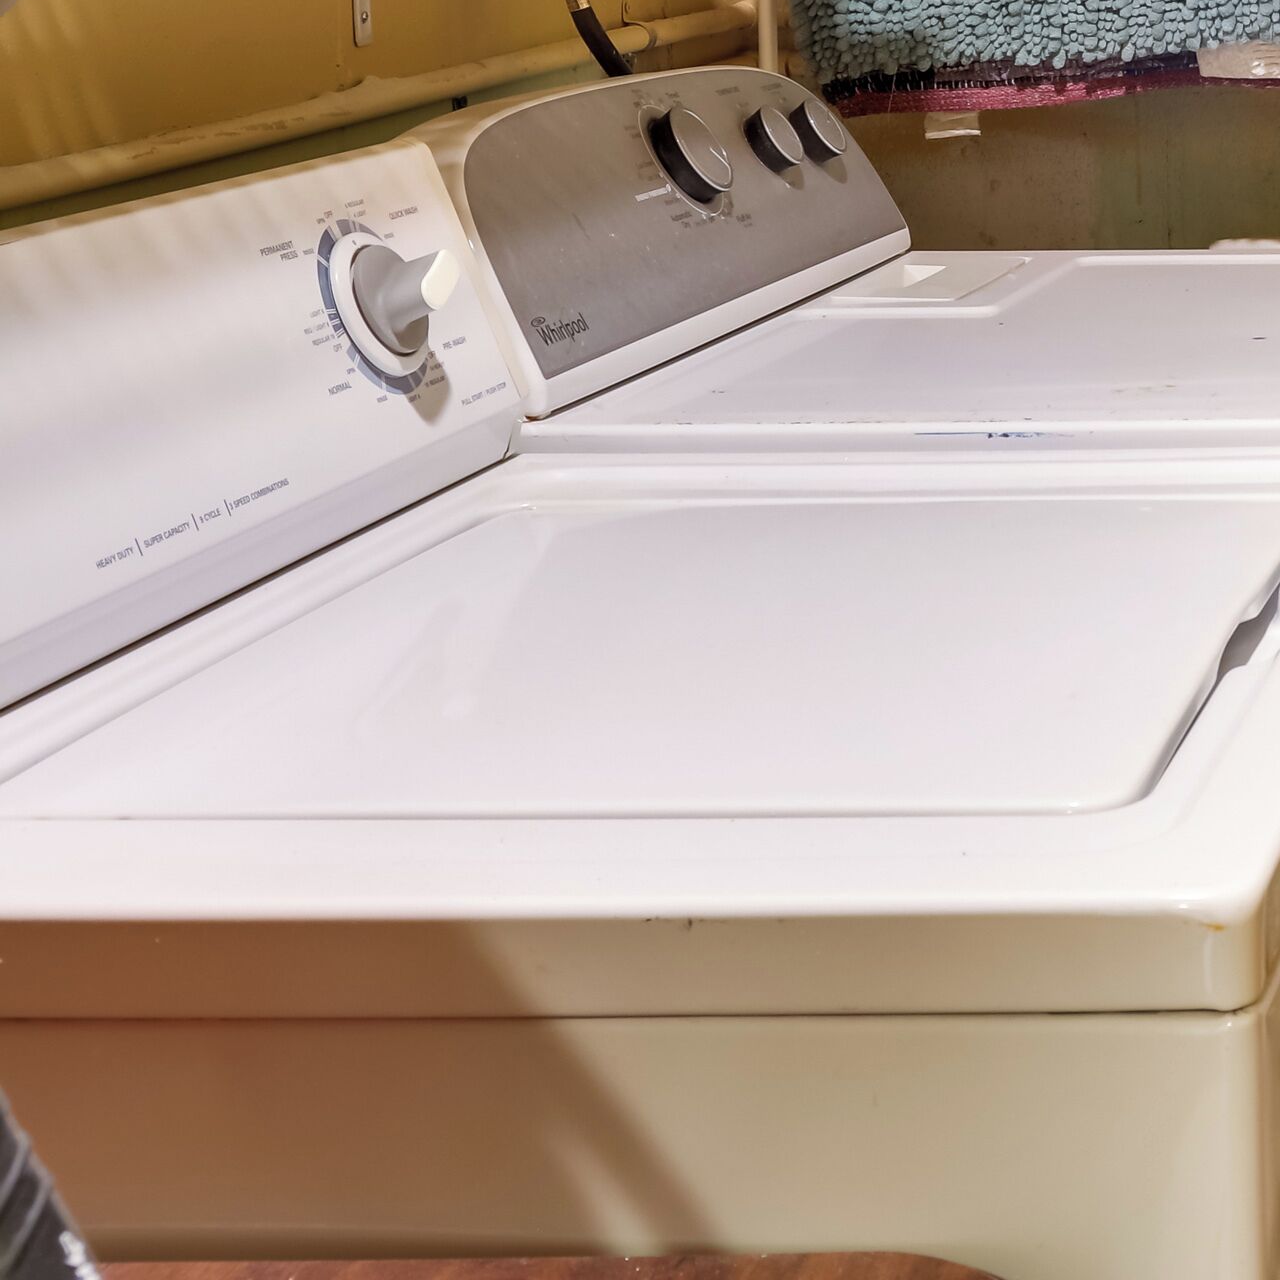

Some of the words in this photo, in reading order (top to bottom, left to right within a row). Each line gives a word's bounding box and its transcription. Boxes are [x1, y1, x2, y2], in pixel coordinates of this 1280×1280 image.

[259, 240, 294, 257] PERMANENT
[279, 251, 299, 262] PRESS
[535, 312, 590, 347] Whirlpool
[328, 381, 352, 396] NORMAL
[96, 553, 118, 570] HEAVY
[116, 546, 135, 562] DUTY
[143, 533, 164, 549] SUPER
[163, 522, 191, 540] CAPACITY
[203, 508, 221, 522] CYCLE
[233, 495, 250, 508] SPEED
[250, 478, 290, 501] COMBINATIONS
